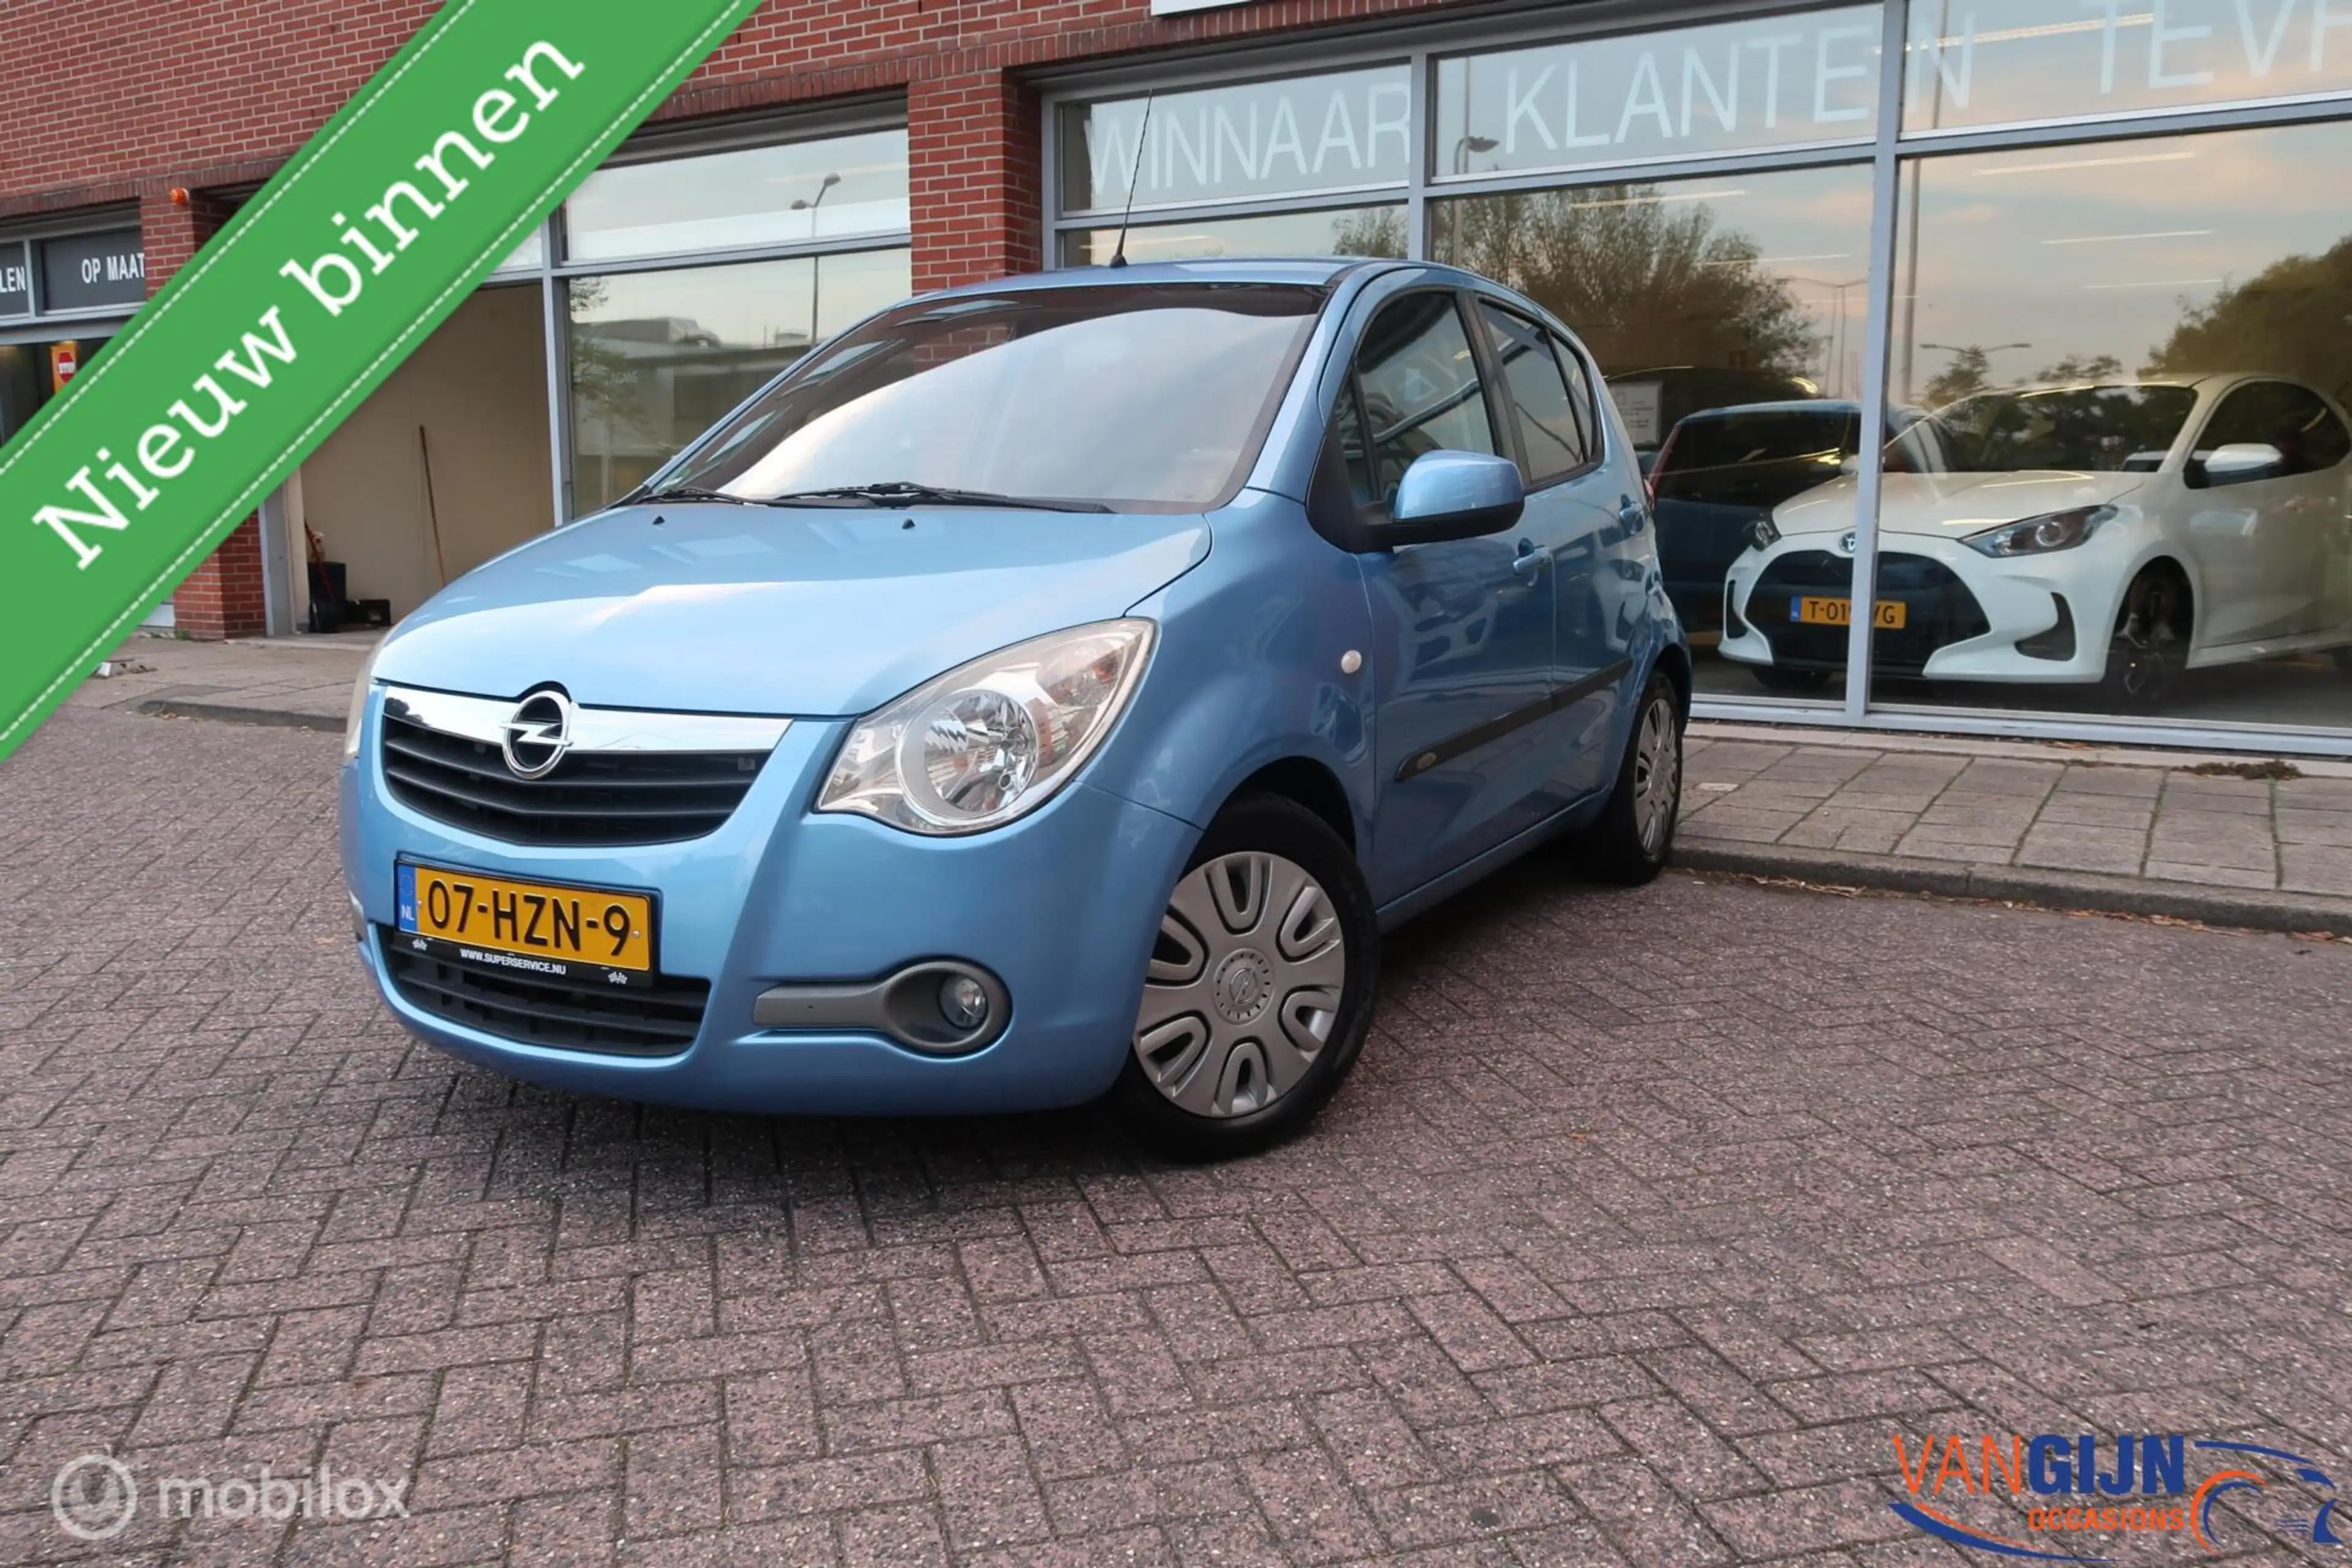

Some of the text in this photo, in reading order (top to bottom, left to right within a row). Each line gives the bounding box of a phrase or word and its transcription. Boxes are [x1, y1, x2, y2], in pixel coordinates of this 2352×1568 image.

[1084, 83, 1410, 196] WINNAAR
[1506, 9, 1975, 154] KLANTEN
[81, 258, 101, 284] OP
[107, 252, 145, 281] MAAT
[402, 905, 415, 921] NL
[428, 878, 630, 957] 07-HZN-9
[460, 948, 566, 975] WWW.SUPERSERVICE.NU
